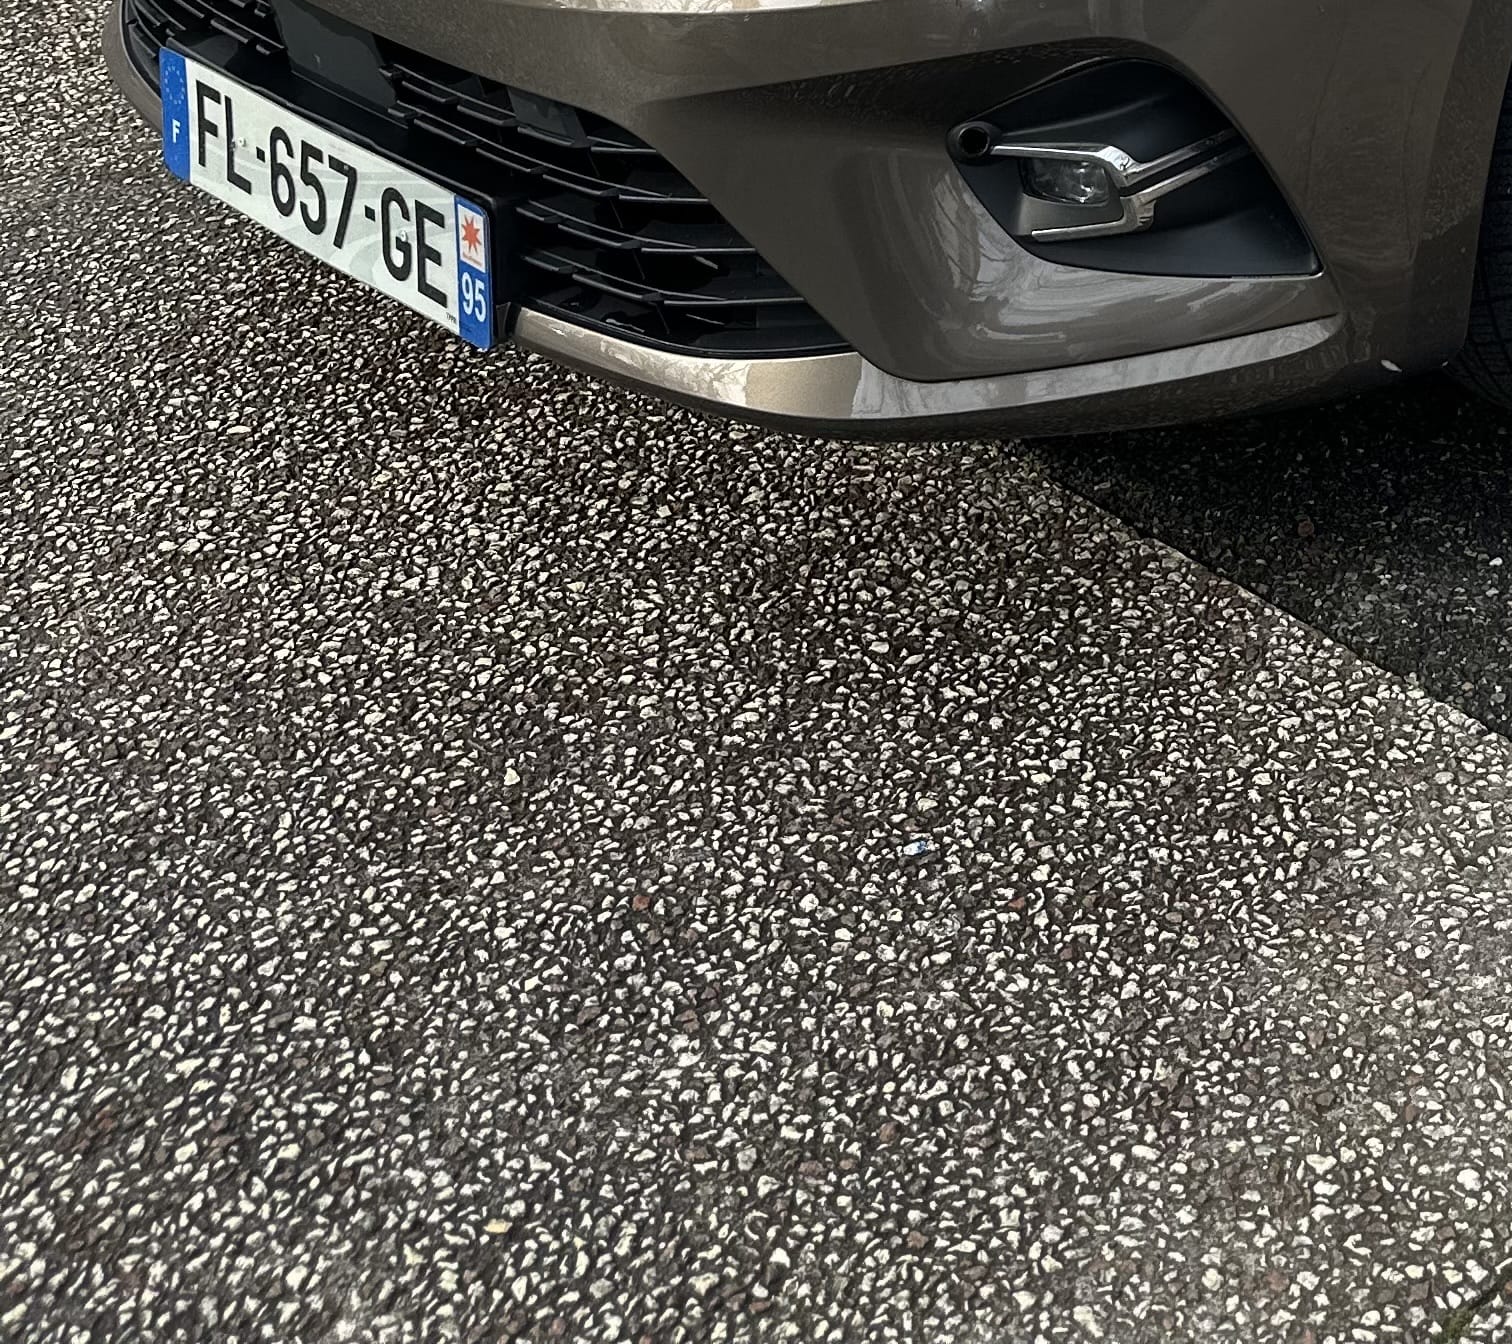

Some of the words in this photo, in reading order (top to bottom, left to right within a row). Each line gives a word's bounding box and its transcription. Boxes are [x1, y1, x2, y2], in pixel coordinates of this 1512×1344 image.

[171, 118, 181, 144] F
[195, 79, 448, 309] FL-657-GE
[461, 271, 486, 323] 95
